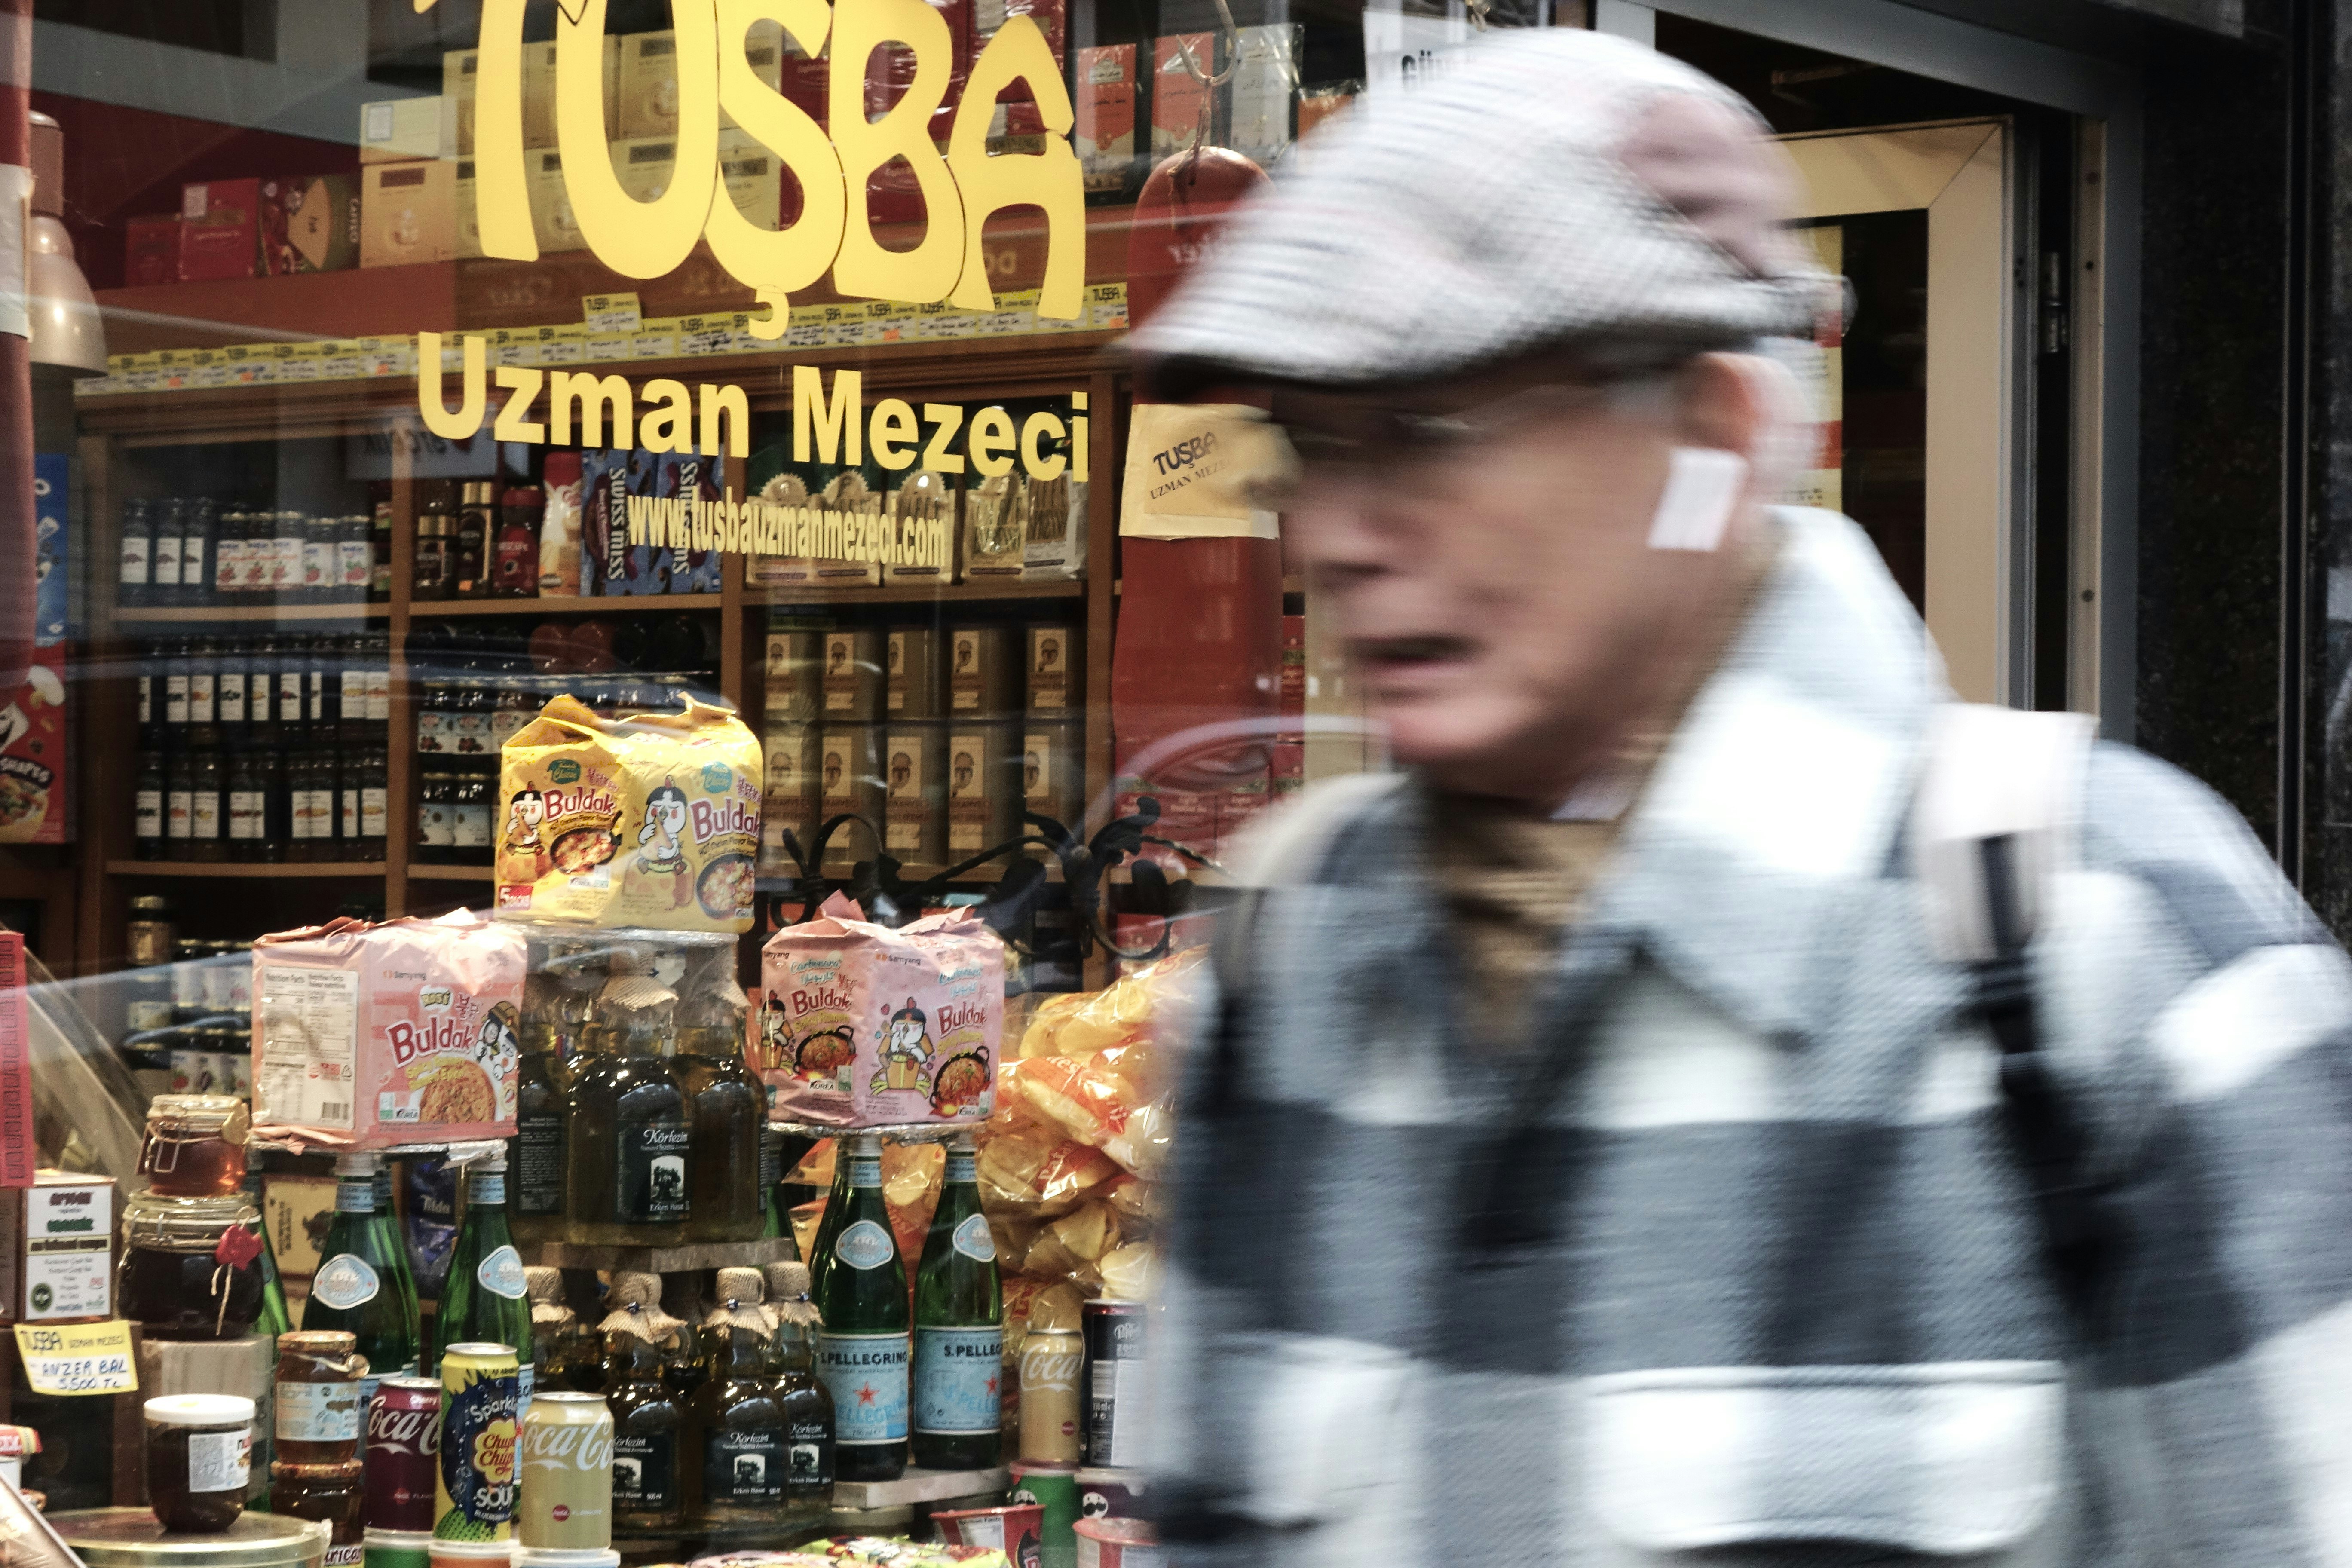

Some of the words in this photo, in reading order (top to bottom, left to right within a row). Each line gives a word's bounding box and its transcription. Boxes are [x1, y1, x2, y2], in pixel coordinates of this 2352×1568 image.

[418, 331, 749, 459] Uzman
[793, 365, 1089, 483] Mezeci
[1153, 431, 1219, 475] TUŞBA
[1150, 474, 1191, 499] UZMAN
[627, 486, 946, 566] www.tusbauzmanmezeci.com
[542, 786, 615, 821] Buldak
[790, 987, 851, 1017] Buldak
[937, 1001, 988, 1038] Buldak
[386, 1016, 474, 1067] Buldak
[98, 1358, 128, 1375] BAL
[469, 1397, 517, 1424] Sparkl
[475, 1485, 513, 1508] SOU
